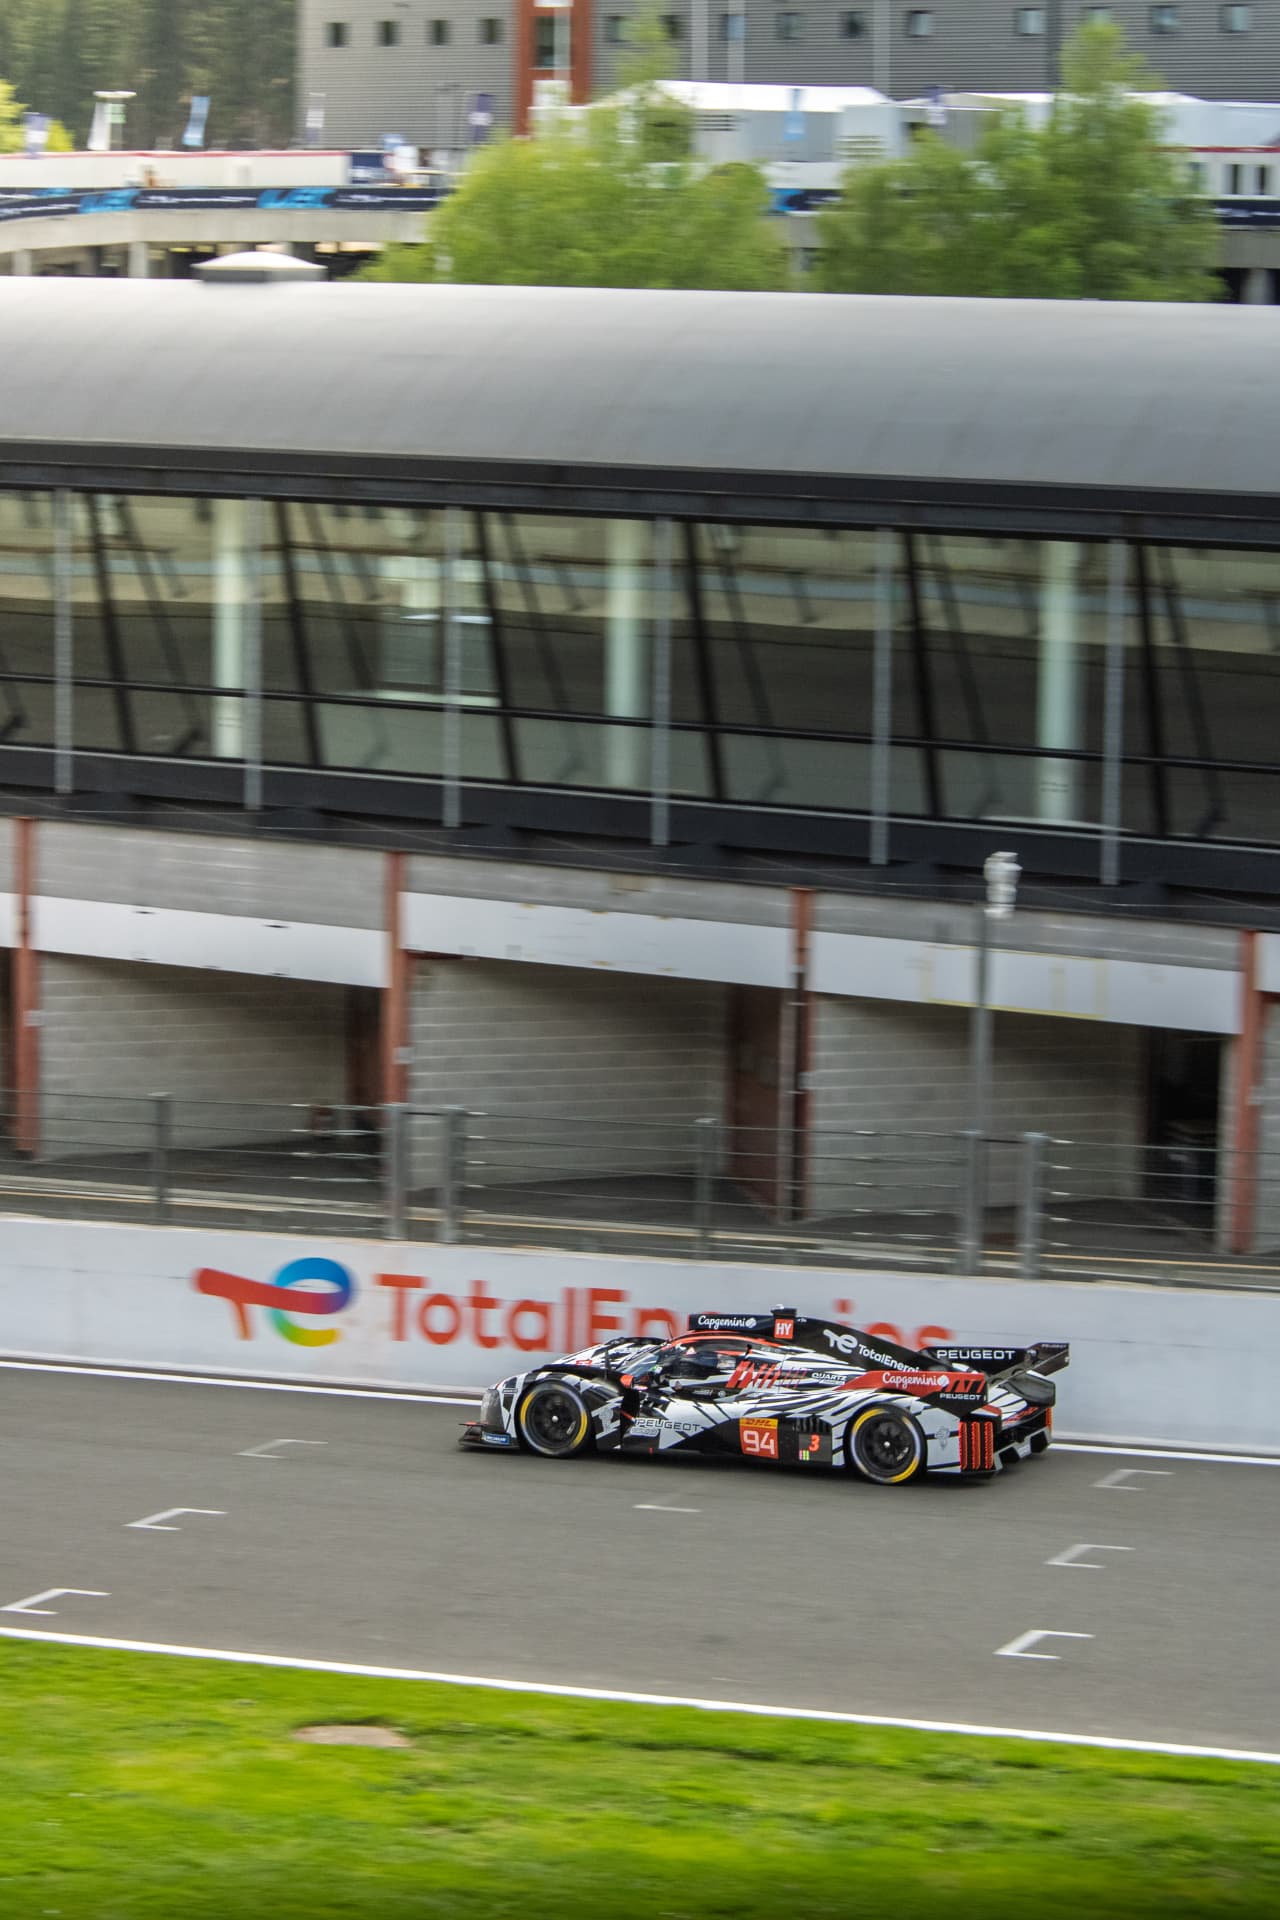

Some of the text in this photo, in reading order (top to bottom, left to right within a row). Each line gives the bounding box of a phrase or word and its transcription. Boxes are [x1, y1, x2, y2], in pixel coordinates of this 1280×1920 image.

[697, 1315, 746, 1330] Capgemini
[775, 1322, 792, 1336] HY
[858, 1344, 920, 1372] TotalEner
[936, 1349, 1016, 1360] PEUGEOT
[811, 1372, 848, 1381] QUARTZ
[882, 1372, 937, 1389] Capgemini
[939, 1392, 982, 1401] PEUGEOT
[635, 1419, 701, 1432] PEUGEOT
[743, 1430, 775, 1457] 94
[809, 1434, 820, 1452] 3
